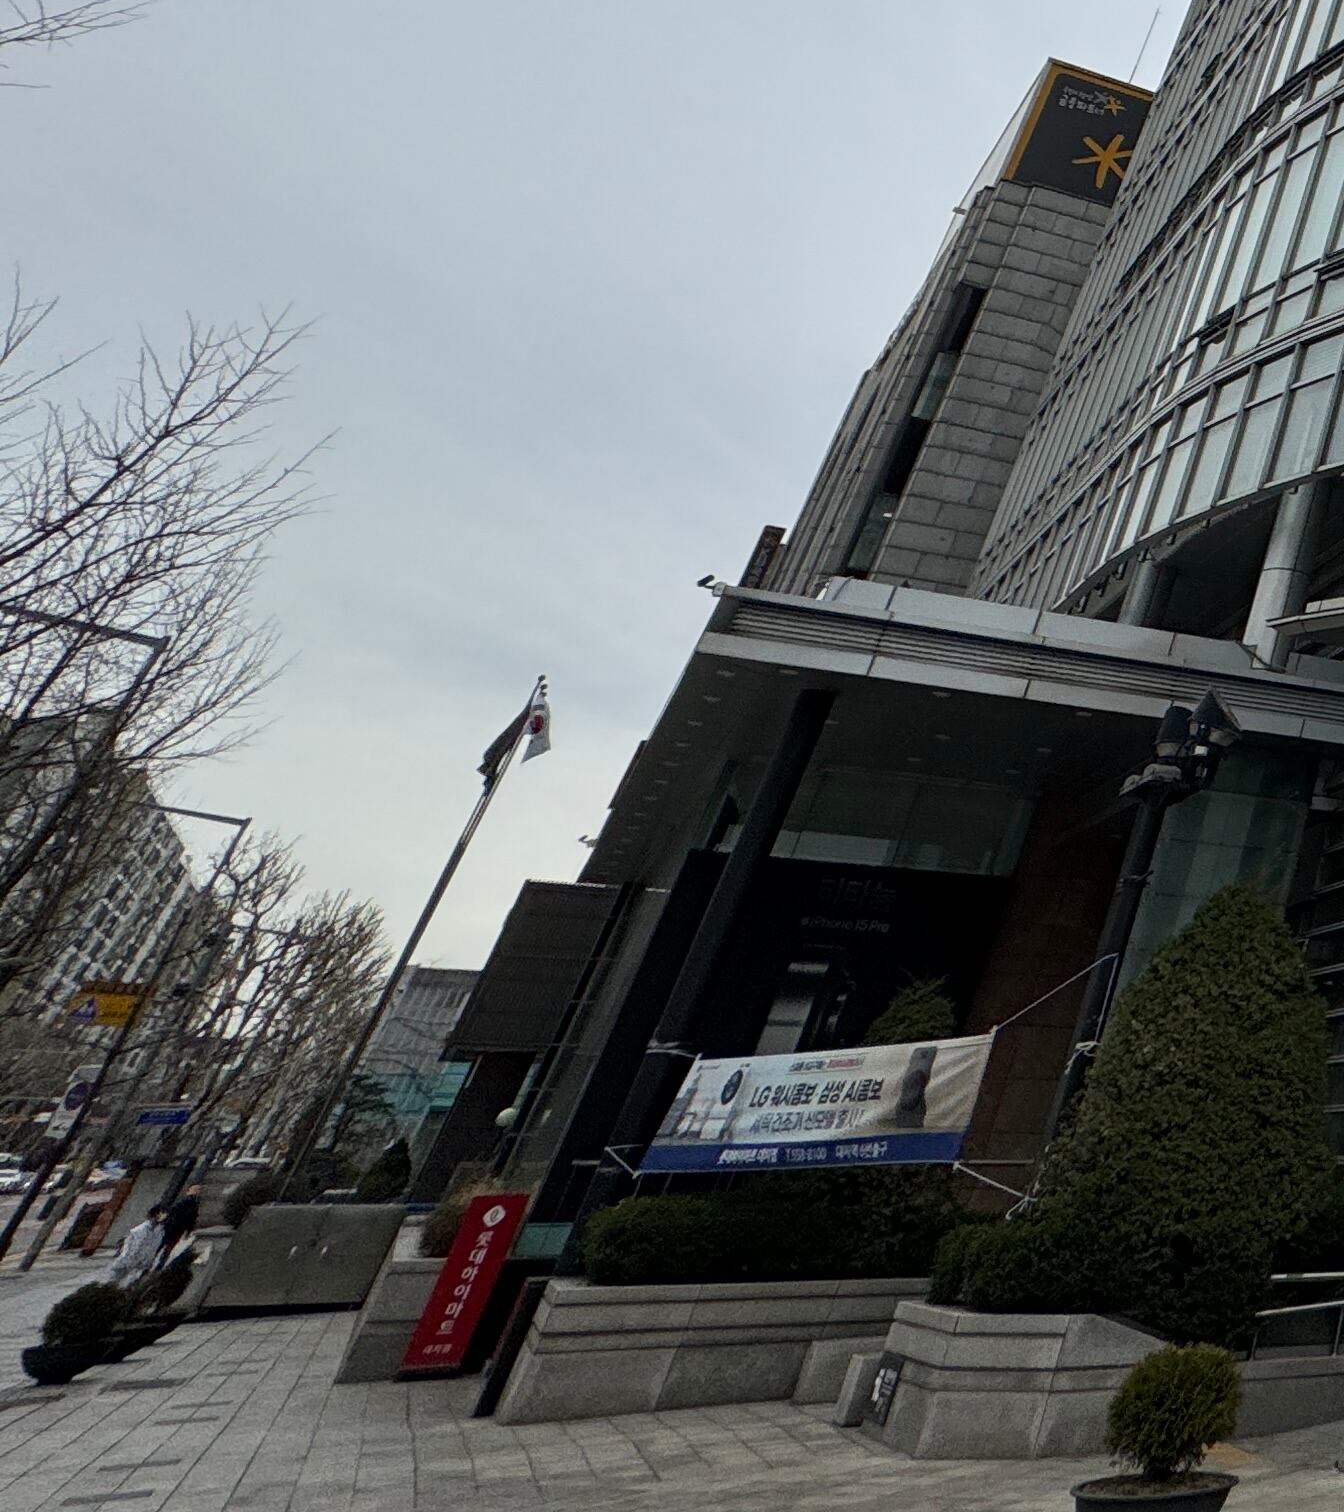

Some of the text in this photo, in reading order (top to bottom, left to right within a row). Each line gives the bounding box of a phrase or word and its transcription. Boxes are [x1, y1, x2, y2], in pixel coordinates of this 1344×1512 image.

[749, 1086, 772, 1108] LG
[818, 1079, 847, 1105] 삼성
[436, 1231, 494, 1335] 롯데하이마트
